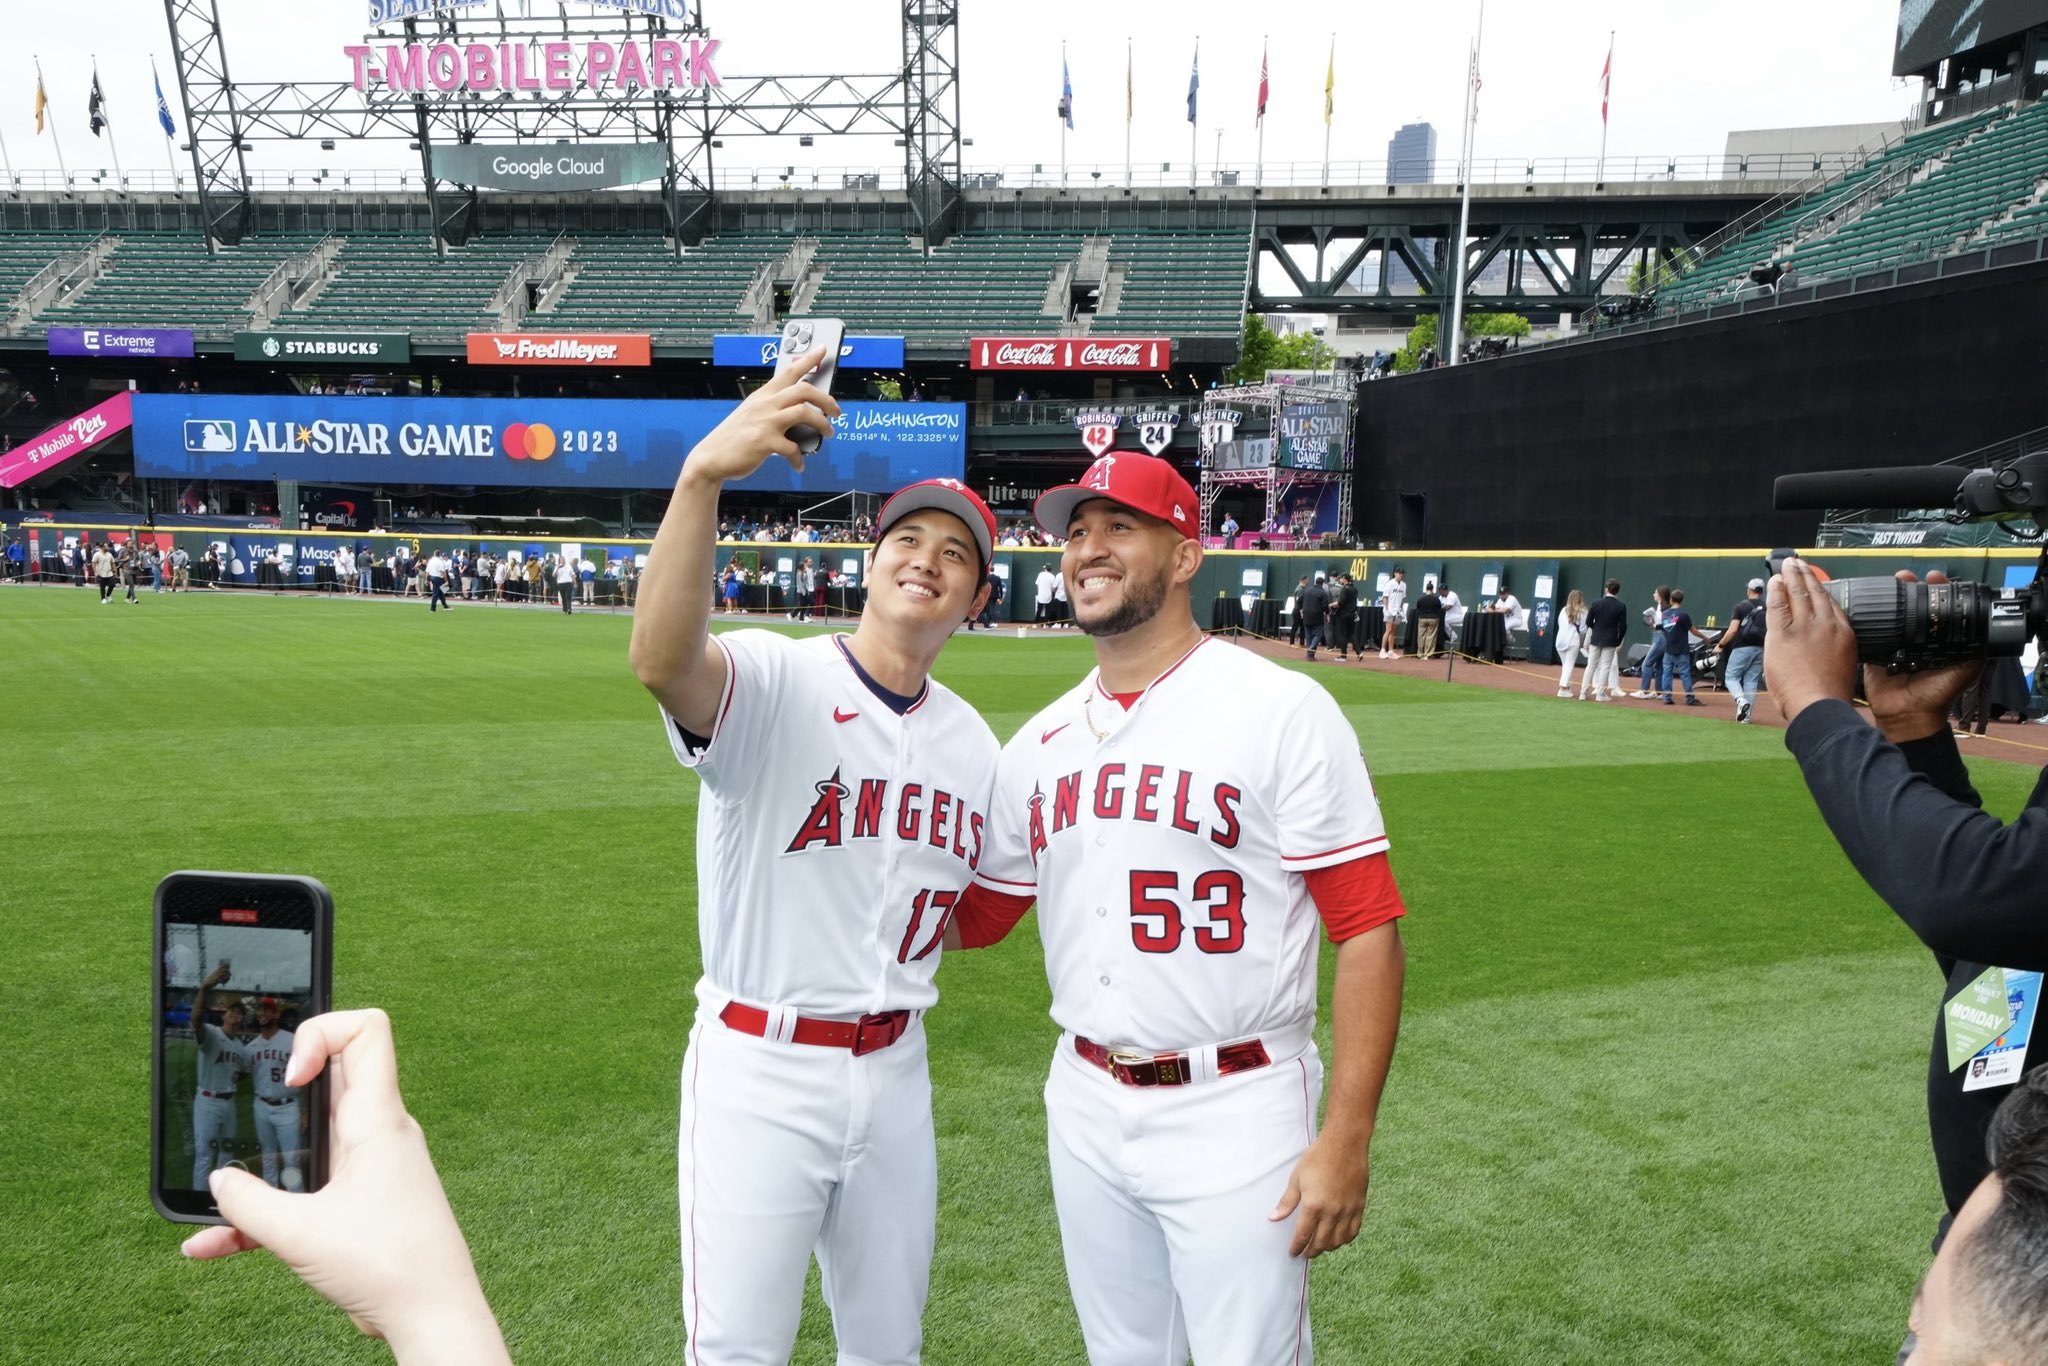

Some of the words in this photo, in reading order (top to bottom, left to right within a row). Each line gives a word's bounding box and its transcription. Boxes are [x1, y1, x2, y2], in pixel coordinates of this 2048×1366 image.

[343, 40, 575, 93] T-MOBILE
[587, 38, 722, 90] PARK
[492, 156, 553, 179] Google
[557, 157, 605, 175] Cloud
[104, 334, 156, 347] Extreme
[285, 341, 379, 355] STARBUCKS
[996, 343, 1058, 365] Coca-Cola
[1080, 343, 1143, 366] Coca-Cola
[1076, 413, 1117, 426] ROBINSON
[1136, 412, 1173, 424] GRIFFEY
[1193, 411, 1238, 423] MINEZ
[1298, 405, 1328, 416] SEATTLE
[39, 431, 75, 459] Mobile
[399, 422, 494, 456] GAME
[562, 430, 618, 453] 2023
[949, 434, 959, 443] W
[1087, 426, 1106, 446] 42
[1146, 425, 1165, 444] 24
[1297, 450, 1321, 464] GAME
[987, 484, 1018, 505] Lite
[1871, 531, 1896, 545] FAST
[1892, 530, 1927, 545] TWITCH
[1349, 557, 1368, 581] 401
[784, 764, 984, 872] ANGELS
[1026, 762, 1242, 869] ANGELS
[1129, 869, 1247, 954] 53
[897, 888, 959, 964] 17
[1949, 1002, 2005, 1031] MONDAY
